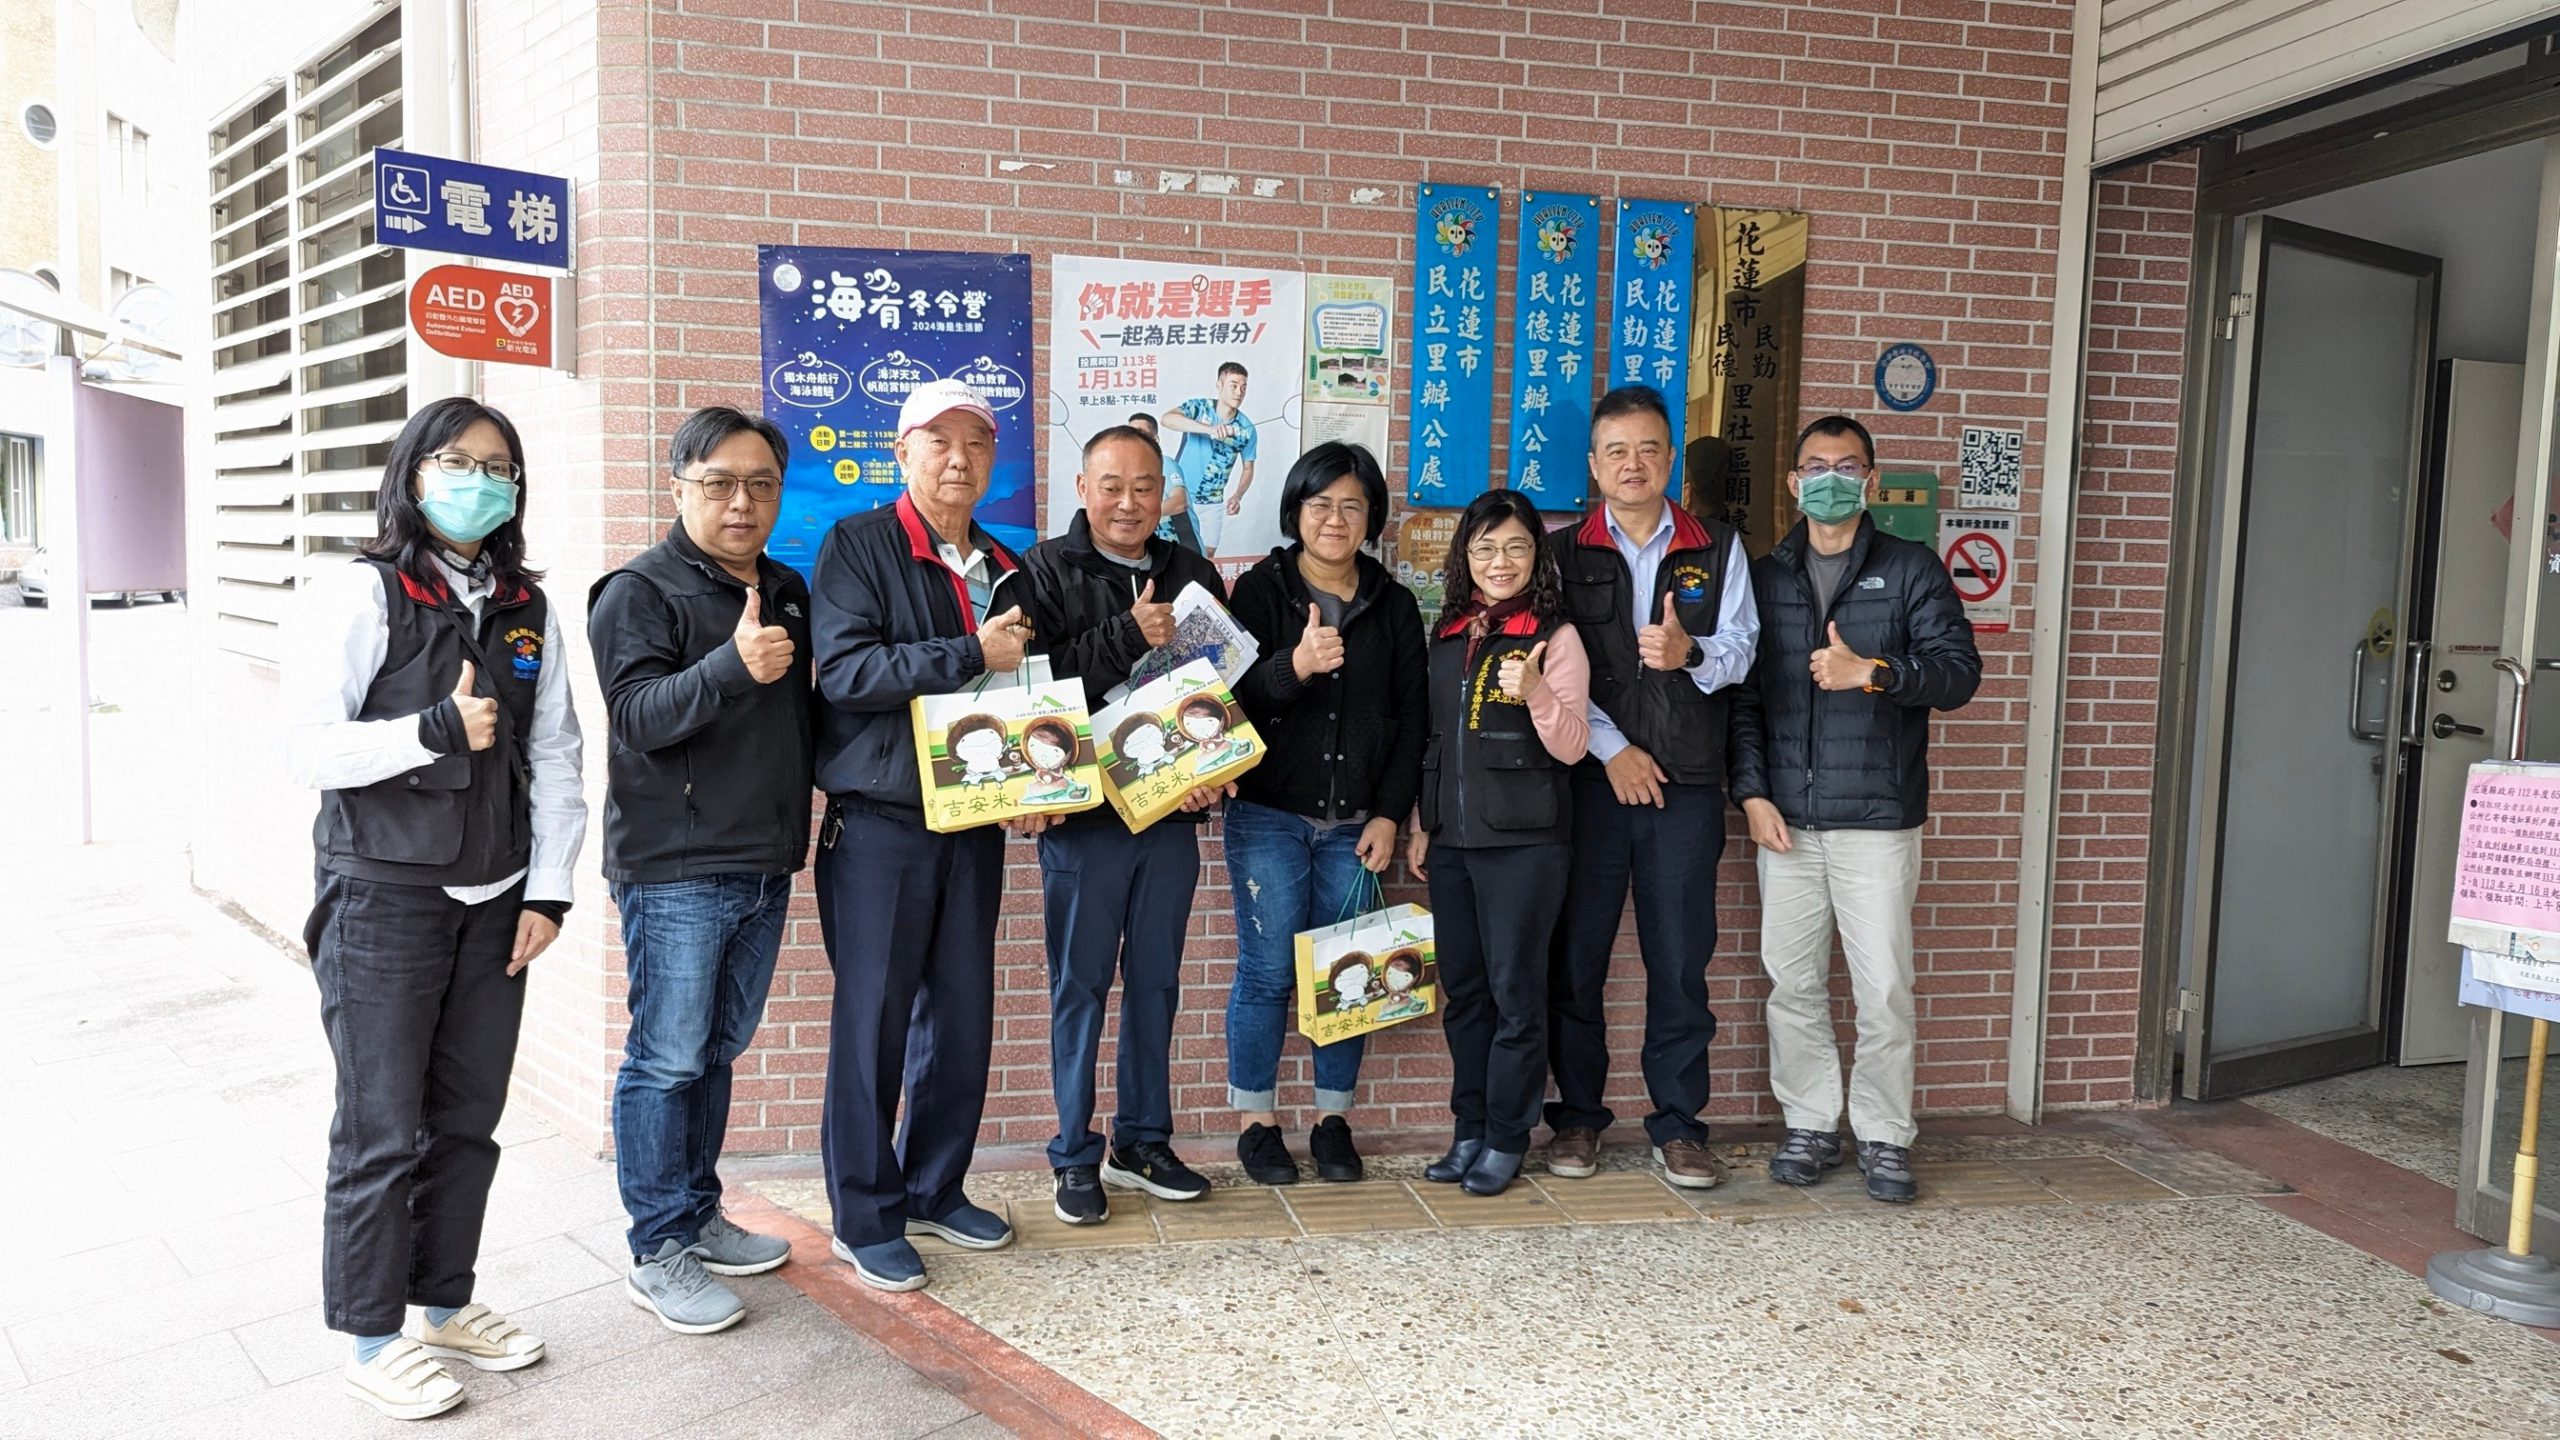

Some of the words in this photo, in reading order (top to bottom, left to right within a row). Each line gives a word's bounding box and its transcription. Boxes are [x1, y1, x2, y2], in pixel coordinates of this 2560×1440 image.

[441, 179, 558, 244] 電梯
[1732, 222, 1765, 328] 花蓮市
[426, 284, 486, 310] AED
[501, 282, 534, 298] AED
[1078, 278, 1272, 322] 你就是選手
[1100, 322, 1251, 348] 一起為民主得分
[1455, 267, 1486, 379] 花蓮市
[1555, 273, 1586, 384] 花蓮市
[1652, 280, 1681, 388] 花蓮市
[1122, 354, 1157, 367] 113年
[1712, 323, 1740, 378] 民德
[1752, 324, 1779, 380] 民勤
[784, 373, 839, 385] 獨木舟航行
[877, 368, 921, 381] 海洋天文
[964, 373, 1007, 386] 食魚教育
[1079, 369, 1158, 390] 1月13日
[1417, 264, 1454, 488] 民立里辦公處
[1518, 270, 1555, 492] 民德里辦公處
[789, 385, 834, 398] 海泳體驗
[1079, 394, 1157, 407] 早上8點-下午4點
[1131, 771, 1190, 809] 吉安米
[943, 792, 1014, 817] 吉安米
[1320, 1013, 1371, 1037] 吉安米
